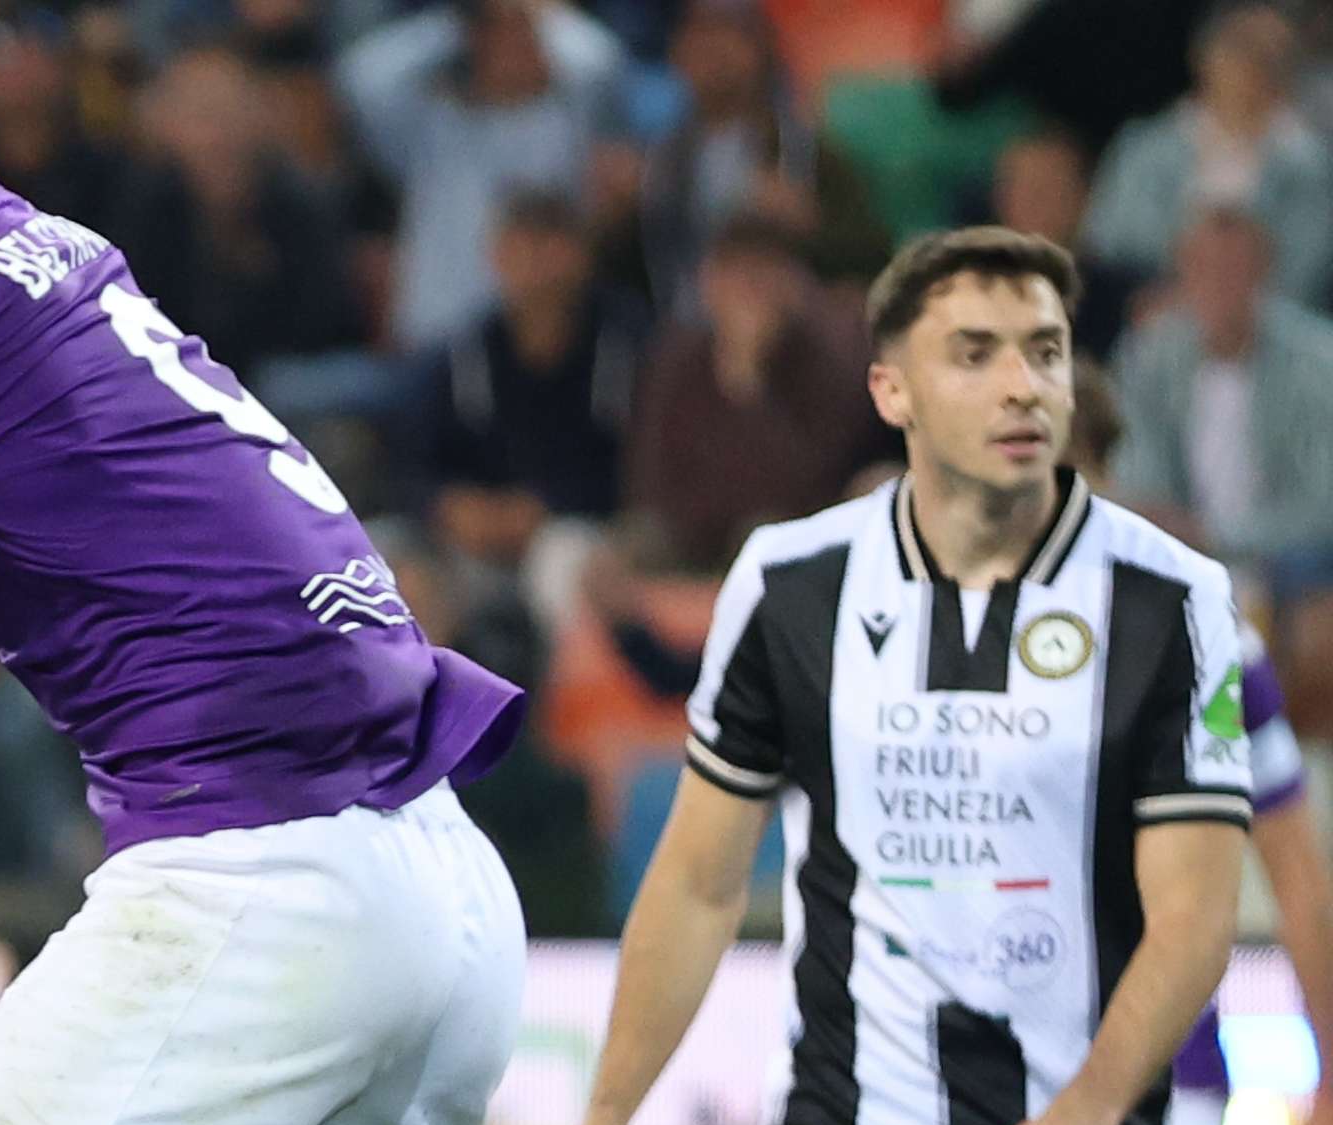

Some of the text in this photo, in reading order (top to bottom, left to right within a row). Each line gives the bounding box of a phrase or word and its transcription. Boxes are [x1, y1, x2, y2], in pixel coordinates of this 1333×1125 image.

[877, 702, 1051, 738] IO SONO
[876, 744, 981, 781] FRIULI
[876, 786, 1035, 823] VENEZIA
[876, 830, 1001, 866] GIULIA
